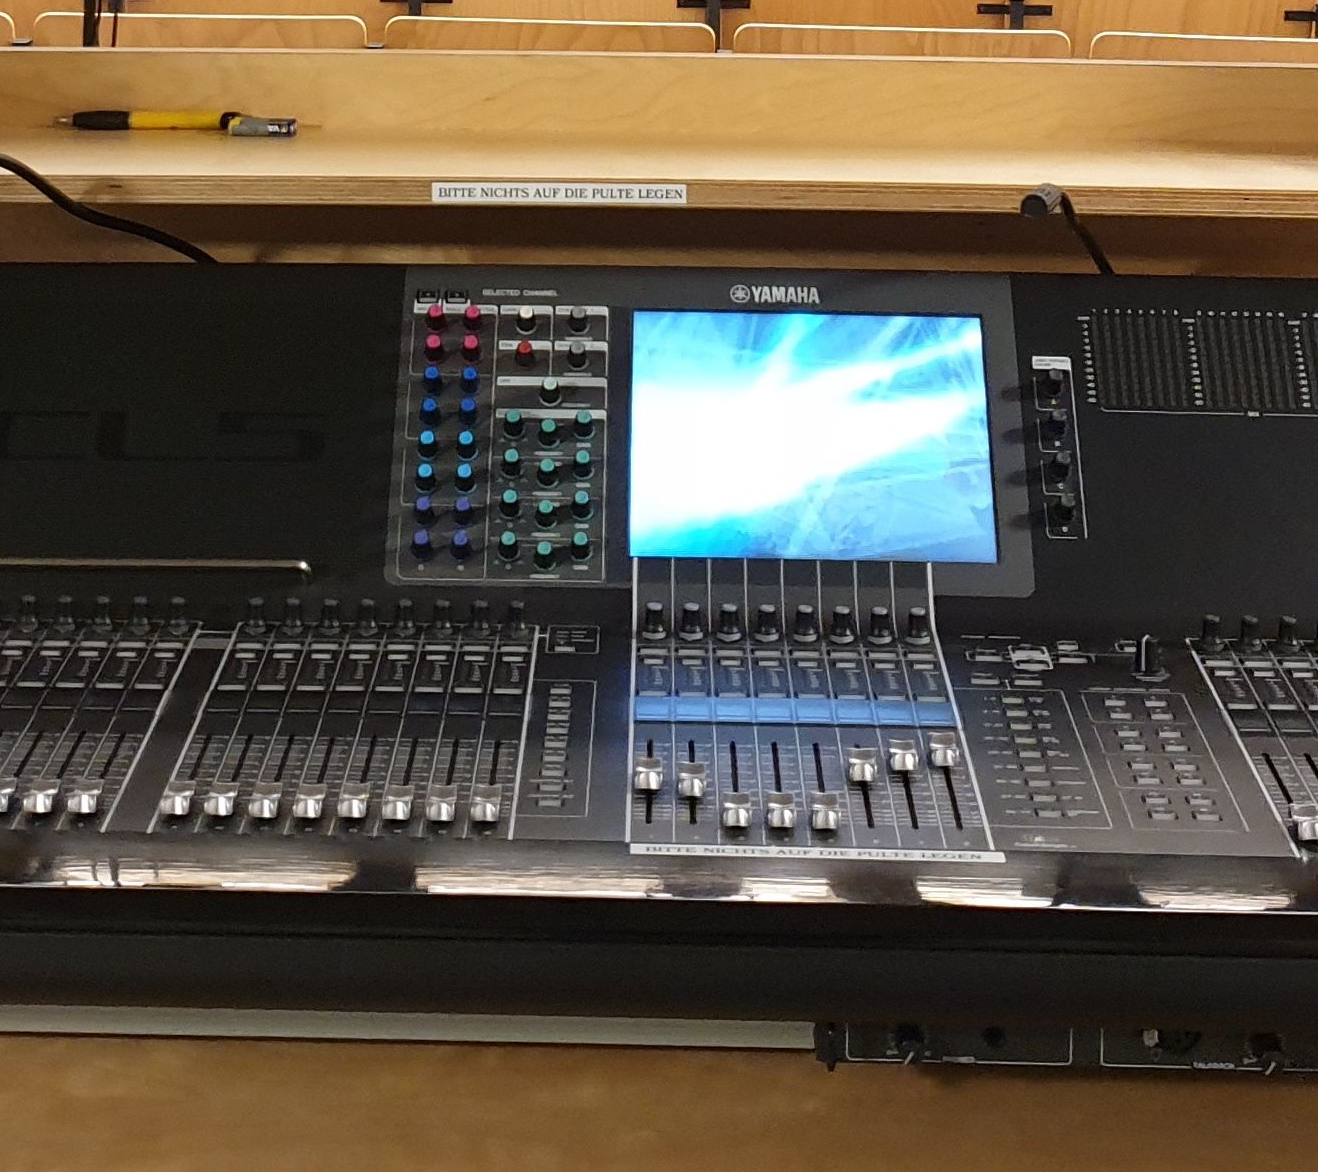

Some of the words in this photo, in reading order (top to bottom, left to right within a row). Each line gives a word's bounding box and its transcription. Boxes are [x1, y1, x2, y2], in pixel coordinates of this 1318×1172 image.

[438, 187, 477, 198] BITTE
[480, 187, 530, 198] NICHTS
[533, 188, 561, 198] AUF
[564, 188, 588, 199] DIE
[592, 188, 635, 199] PULTE
[638, 188, 683, 200] LEGEN
[751, 285, 820, 304] YAMAHA
[645, 846, 698, 854] BITTE
[703, 847, 770, 855] NICHTS
[776, 848, 813, 856] AUF
[819, 849, 850, 857] DIE
[857, 851, 915, 859] PULTE
[921, 852, 981, 860] LEGEN
